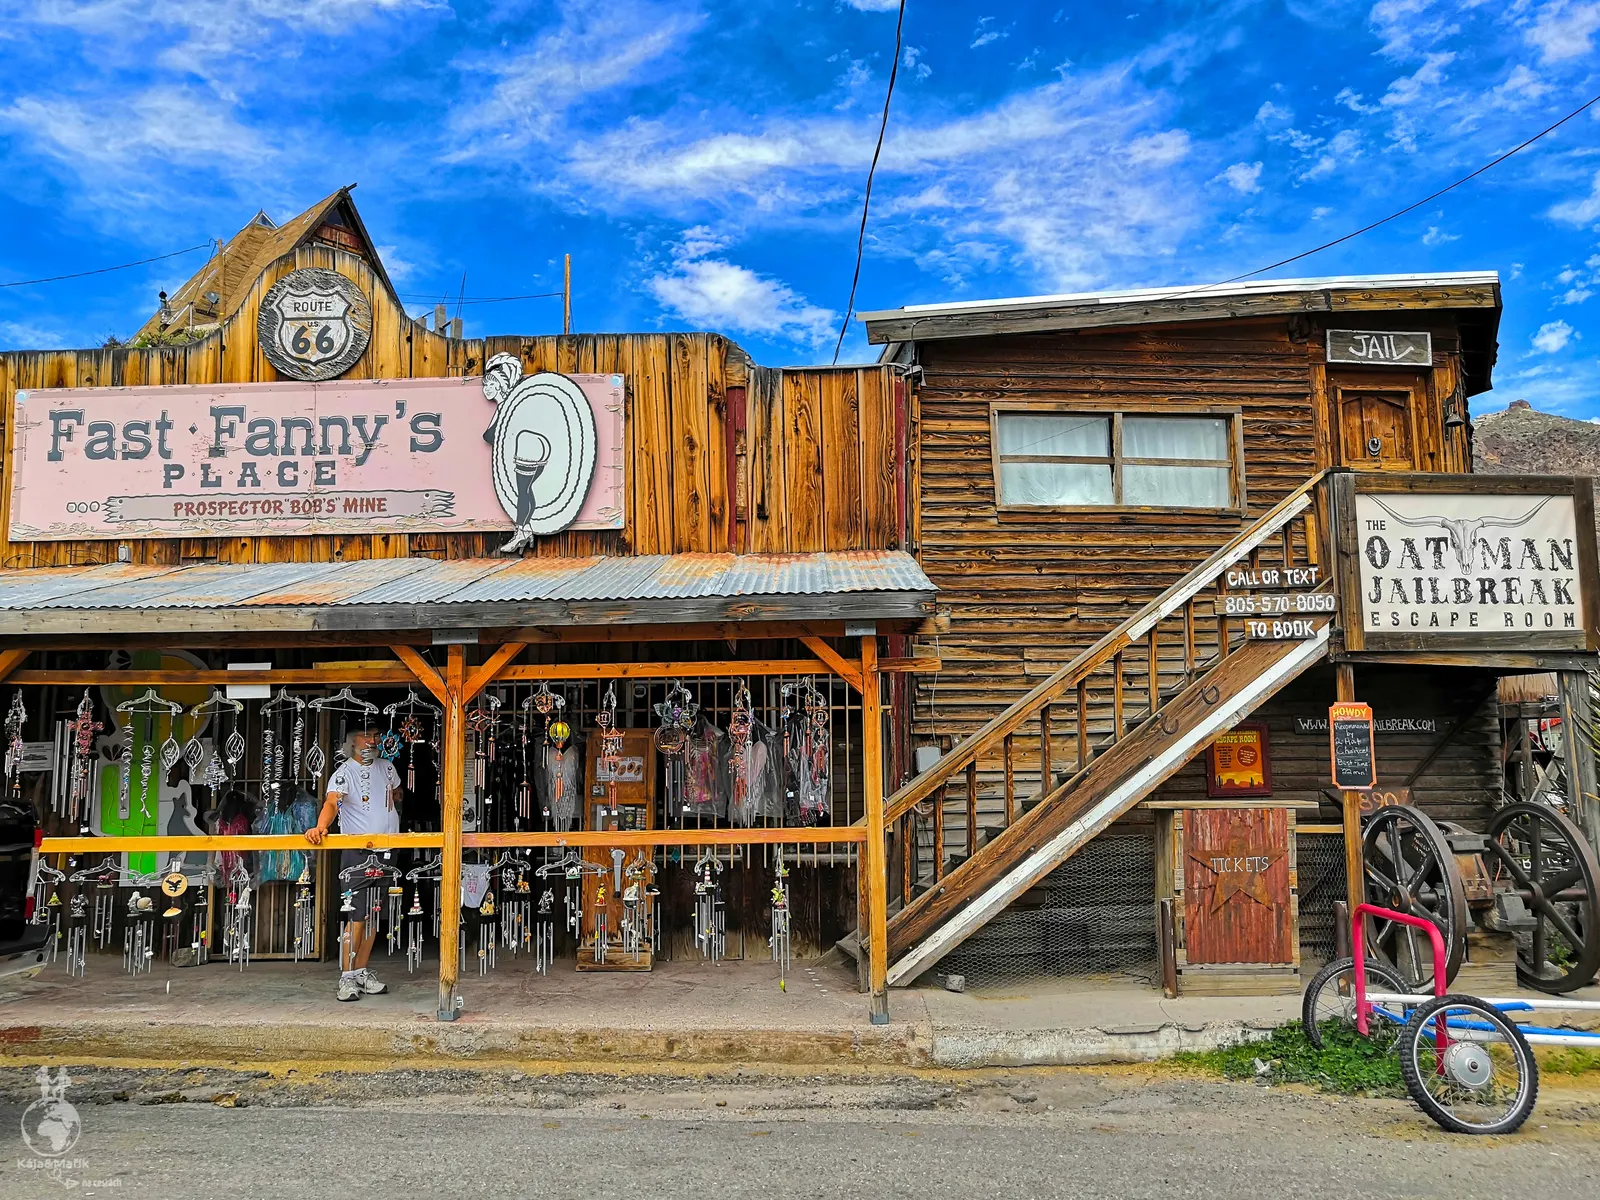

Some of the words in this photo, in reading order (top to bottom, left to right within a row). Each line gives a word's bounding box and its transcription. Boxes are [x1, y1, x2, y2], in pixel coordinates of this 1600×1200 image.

[293, 301, 333, 312] ROUTE
[291, 324, 335, 355] 66
[1348, 335, 1415, 360] JAIL
[47, 409, 174, 462] Fast
[208, 399, 445, 467] Fanny's
[173, 499, 284, 517] PROSPECTOR
[342, 497, 388, 513] MINE
[1365, 519, 1387, 531] THE
[1227, 571, 1260, 587] CALL
[1262, 569, 1280, 585] OR
[1282, 567, 1319, 585] TEXT
[1367, 575, 1575, 606] JAILBREAK
[1225, 594, 1336, 614] 805-570-8050
[1370, 611, 1479, 627] ESCAPE
[1503, 611, 1576, 627] ROOM
[1247, 621, 1267, 637] TO
[1272, 620, 1316, 639] BOOK
[1332, 707, 1367, 718] HOWDY
[1215, 735, 1238, 743] ESCAPE
[1239, 735, 1257, 743] ROOM
[1210, 856, 1269, 873] TICKETS
